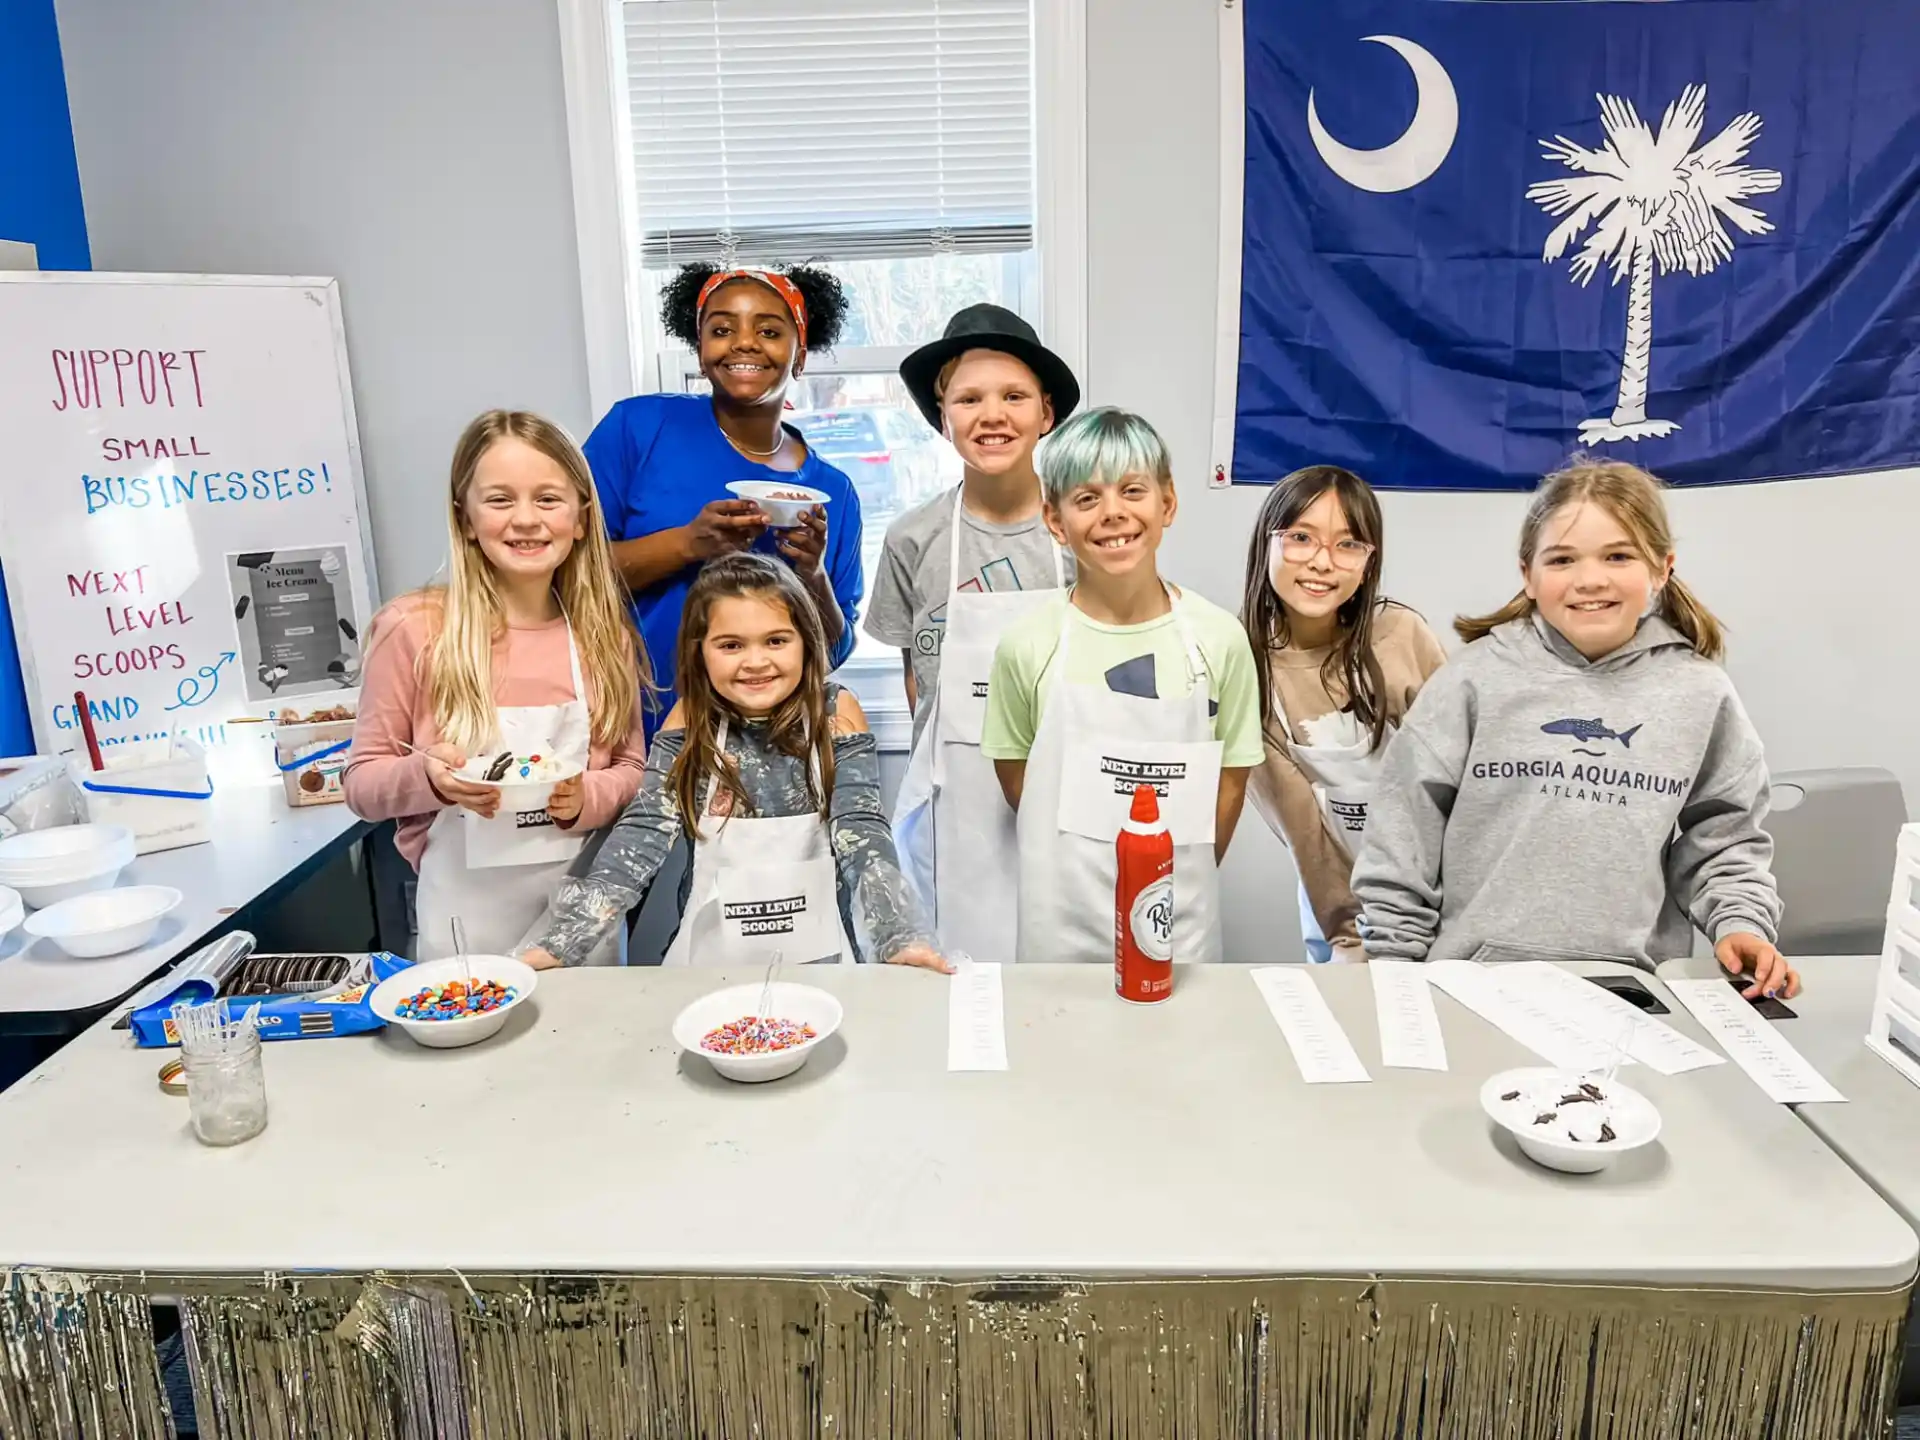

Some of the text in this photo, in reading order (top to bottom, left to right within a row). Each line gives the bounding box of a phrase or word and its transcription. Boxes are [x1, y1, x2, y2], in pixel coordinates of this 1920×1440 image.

[52, 349, 207, 411] SUPPORT
[103, 436, 211, 462] SMALL
[82, 463, 333, 515] BUSINESSES!
[275, 567, 304, 576] Menu
[67, 566, 151, 598] NEXT
[266, 577, 318, 589] Ice Cream
[106, 601, 194, 636] LEVEL
[74, 643, 186, 679] SCOOPS
[1101, 759, 1184, 777] NEXT LEVEL
[1472, 760, 1565, 780] GEORGIA
[1114, 780, 1168, 794] SCPS
[1540, 784, 1628, 807] ATLANTA
[517, 811, 553, 825] SCOO
[725, 898, 805, 917] NEXT LEVEL
[741, 918, 793, 933] SCOOPS
